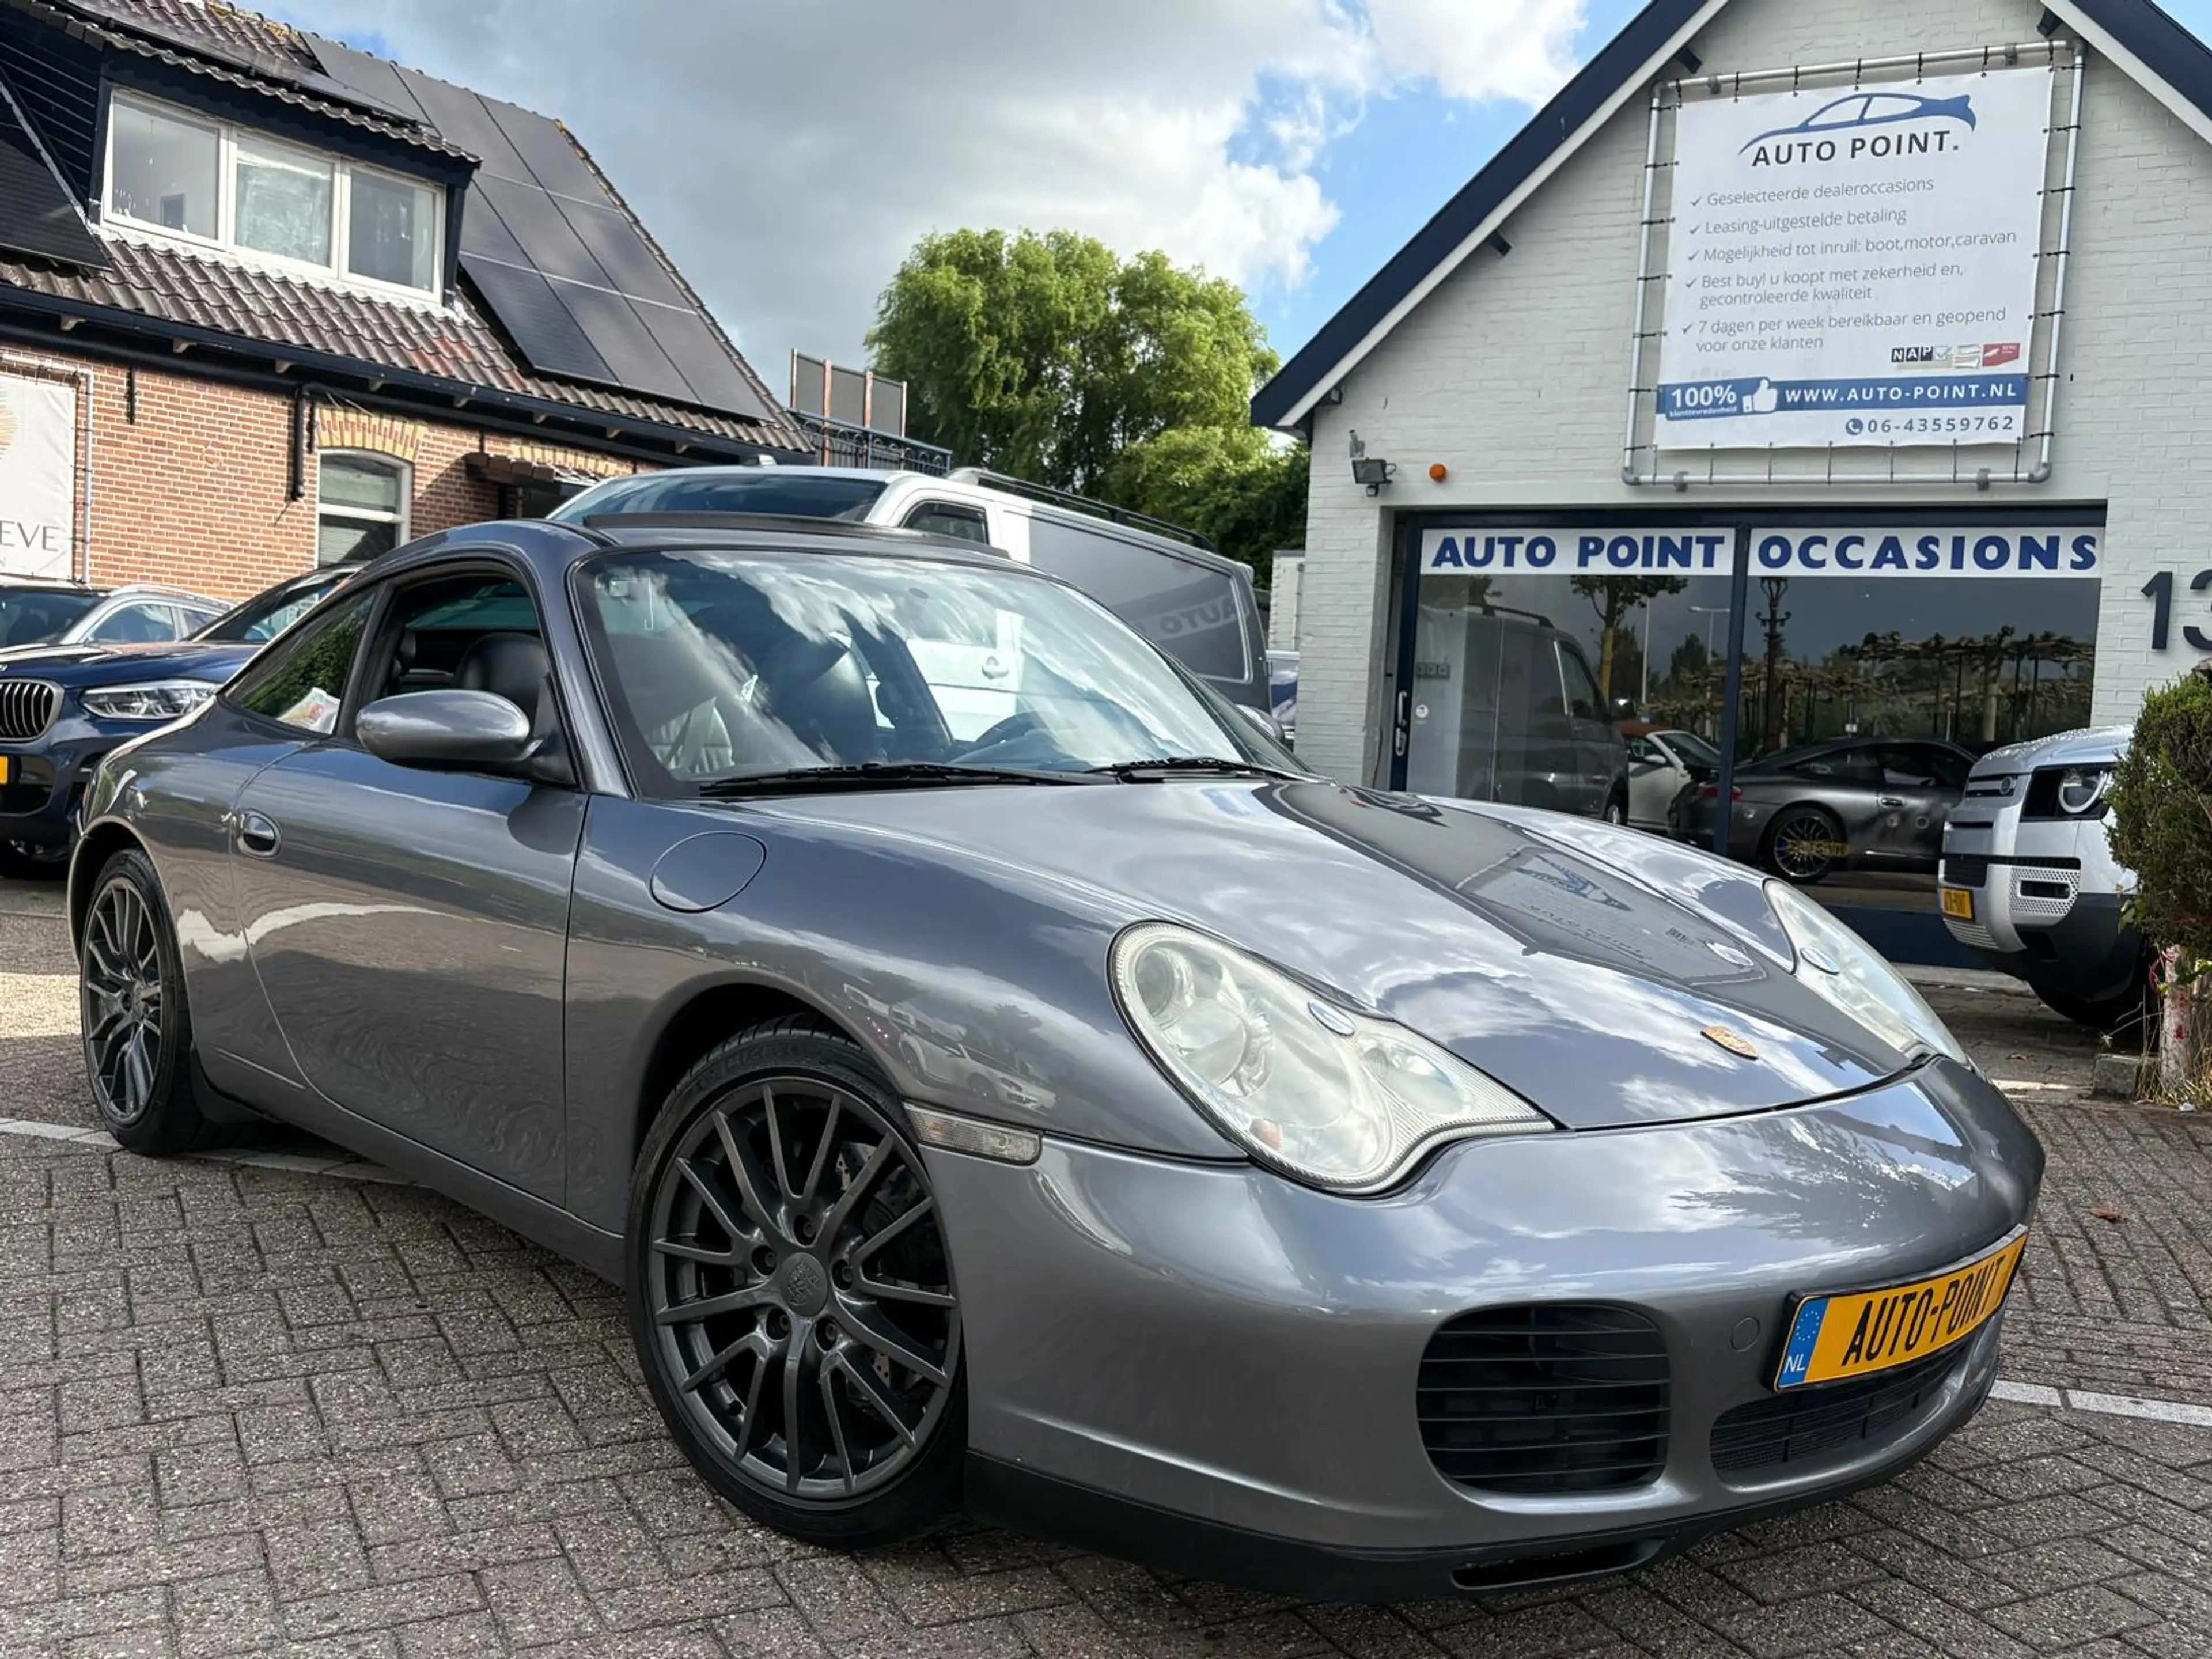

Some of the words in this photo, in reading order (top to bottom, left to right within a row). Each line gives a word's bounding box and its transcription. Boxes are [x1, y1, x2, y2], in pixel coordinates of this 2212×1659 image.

[1752, 141, 1836, 166] AUTO
[1707, 186, 1810, 206] Geselecteerde
[1814, 179, 1935, 199] dealeroccasions
[1705, 211, 1843, 235] Leasing-uitgestelde
[1847, 207, 1907, 225] betaling
[1703, 243, 1792, 263] Mogelijkheid
[1796, 244, 1816, 255] tot
[1820, 238, 1861, 255] inruil:
[1865, 232, 2016, 252] boot,motor,caravan
[1701, 275, 1732, 289] Best
[1770, 274, 1779, 285] u
[1783, 271, 1825, 286] koopt
[1829, 269, 1858, 282] met
[1862, 263, 1936, 281] zekerheid
[1699, 289, 1809, 309] gecontroleerde
[1812, 286, 1873, 301] kwaliteit
[1699, 320, 1707, 334] 7
[1711, 320, 1755, 336] dagen
[1758, 319, 1783, 334] per
[1787, 316, 1825, 330] week
[1828, 313, 1909, 329] bereikbaar
[1912, 313, 1931, 325] en
[1936, 307, 2006, 327] geopend
[1696, 341, 1728, 353] voor
[1731, 339, 1767, 351] onze
[1770, 336, 1823, 350] klanten
[1892, 346, 1933, 363] NAP
[1671, 384, 1737, 408] 100%
[1785, 383, 2017, 403] WWW.AUTO-POINT.NL
[1867, 416, 2013, 433] 06-43559762
[1431, 536, 1556, 568] AUTO
[1577, 536, 1725, 568] POINT
[1758, 535, 2097, 570] OCCASIONS
[1841, 1255, 2006, 1368] AUTO-POINT
[1783, 1353, 1805, 1374] NL
